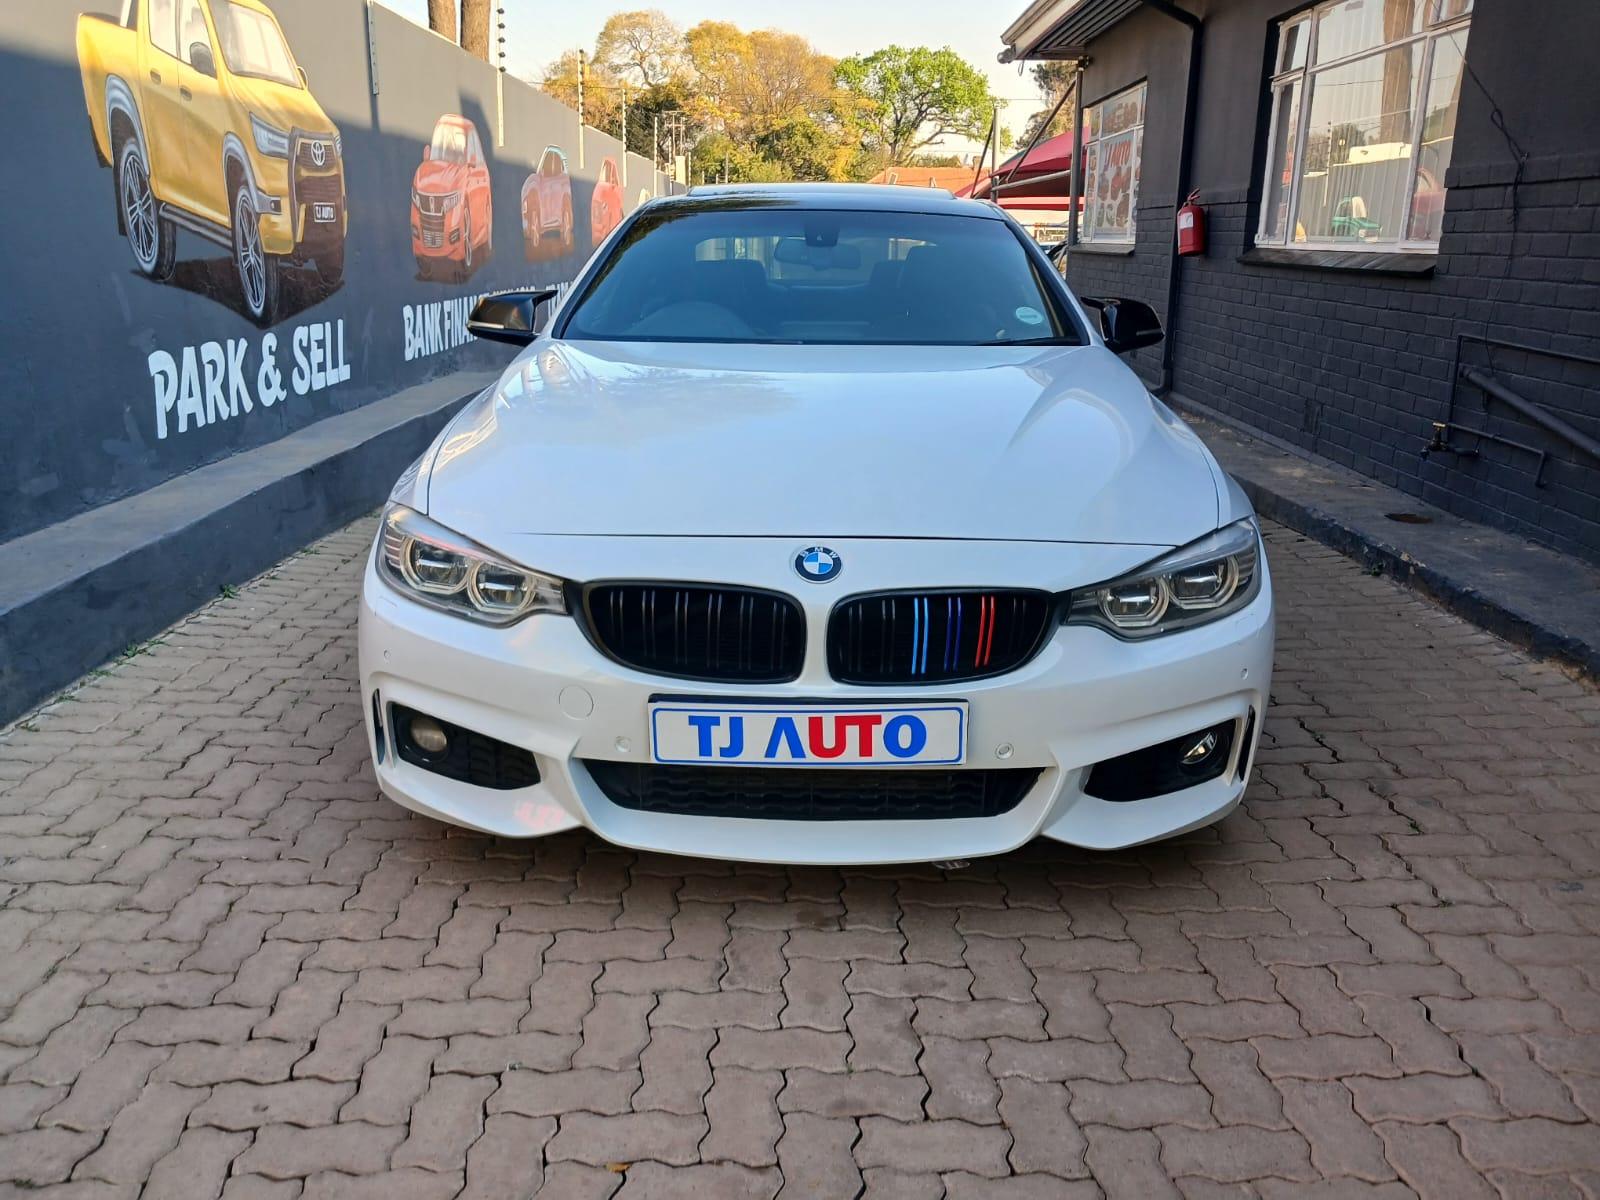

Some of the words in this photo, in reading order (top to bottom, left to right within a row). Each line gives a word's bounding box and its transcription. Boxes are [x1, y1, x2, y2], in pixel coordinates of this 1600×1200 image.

[402, 302, 443, 361] BANK
[443, 292, 490, 351] FINAN
[148, 337, 254, 440] PARK
[257, 332, 288, 407] &
[292, 318, 351, 396] SELL
[688, 715, 744, 758] TJ
[764, 714, 927, 759] AUTO
